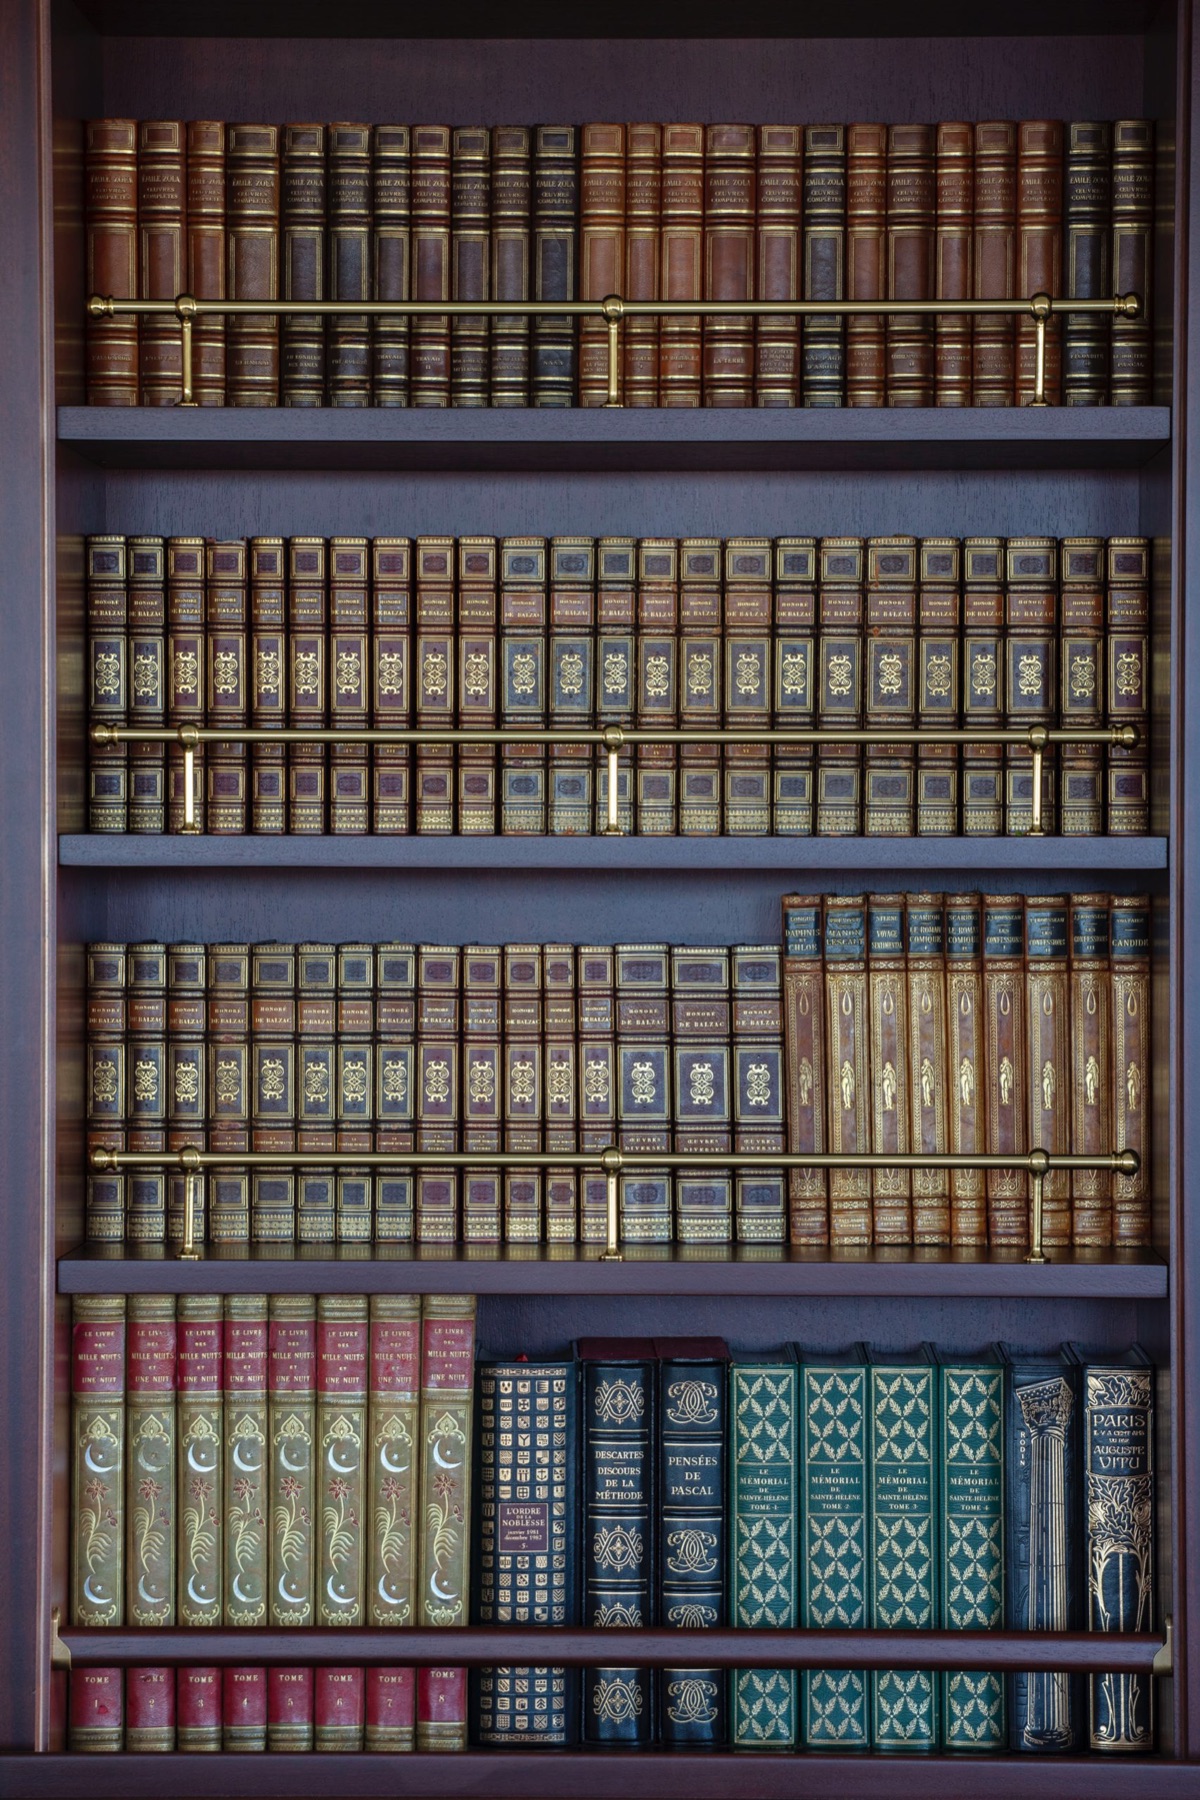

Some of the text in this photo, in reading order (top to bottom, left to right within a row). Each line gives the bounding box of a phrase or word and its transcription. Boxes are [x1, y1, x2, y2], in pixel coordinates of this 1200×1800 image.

[786, 929, 820, 937] DAPHNIS
[877, 930, 897, 938] VOYAGE
[1112, 939, 1148, 947] CANDIDE
[1093, 1415, 1145, 1428] PARIS
[1094, 1446, 1144, 1454] AUGUSTE
[595, 1451, 644, 1459] DESCARTES
[668, 1455, 718, 1466] PENSÉES
[1099, 1457, 1140, 1469] VITU
[685, 1472, 700, 1480] DE
[812, 1475, 860, 1484] MÉMORIAL
[879, 1474, 927, 1484] MÉMORIAL
[740, 1476, 789, 1485] MÉMORIAL
[671, 1486, 713, 1495] PASCAL
[596, 1490, 643, 1500] MÉTHODE
[242, 1698, 248, 1706] 4
[287, 1698, 293, 1706] 5
[337, 1698, 342, 1706] 6
[439, 1694, 445, 1702] 8
[94, 1700, 98, 1708] 1
[149, 1699, 155, 1708] 2
[387, 1699, 392, 1707] 7
